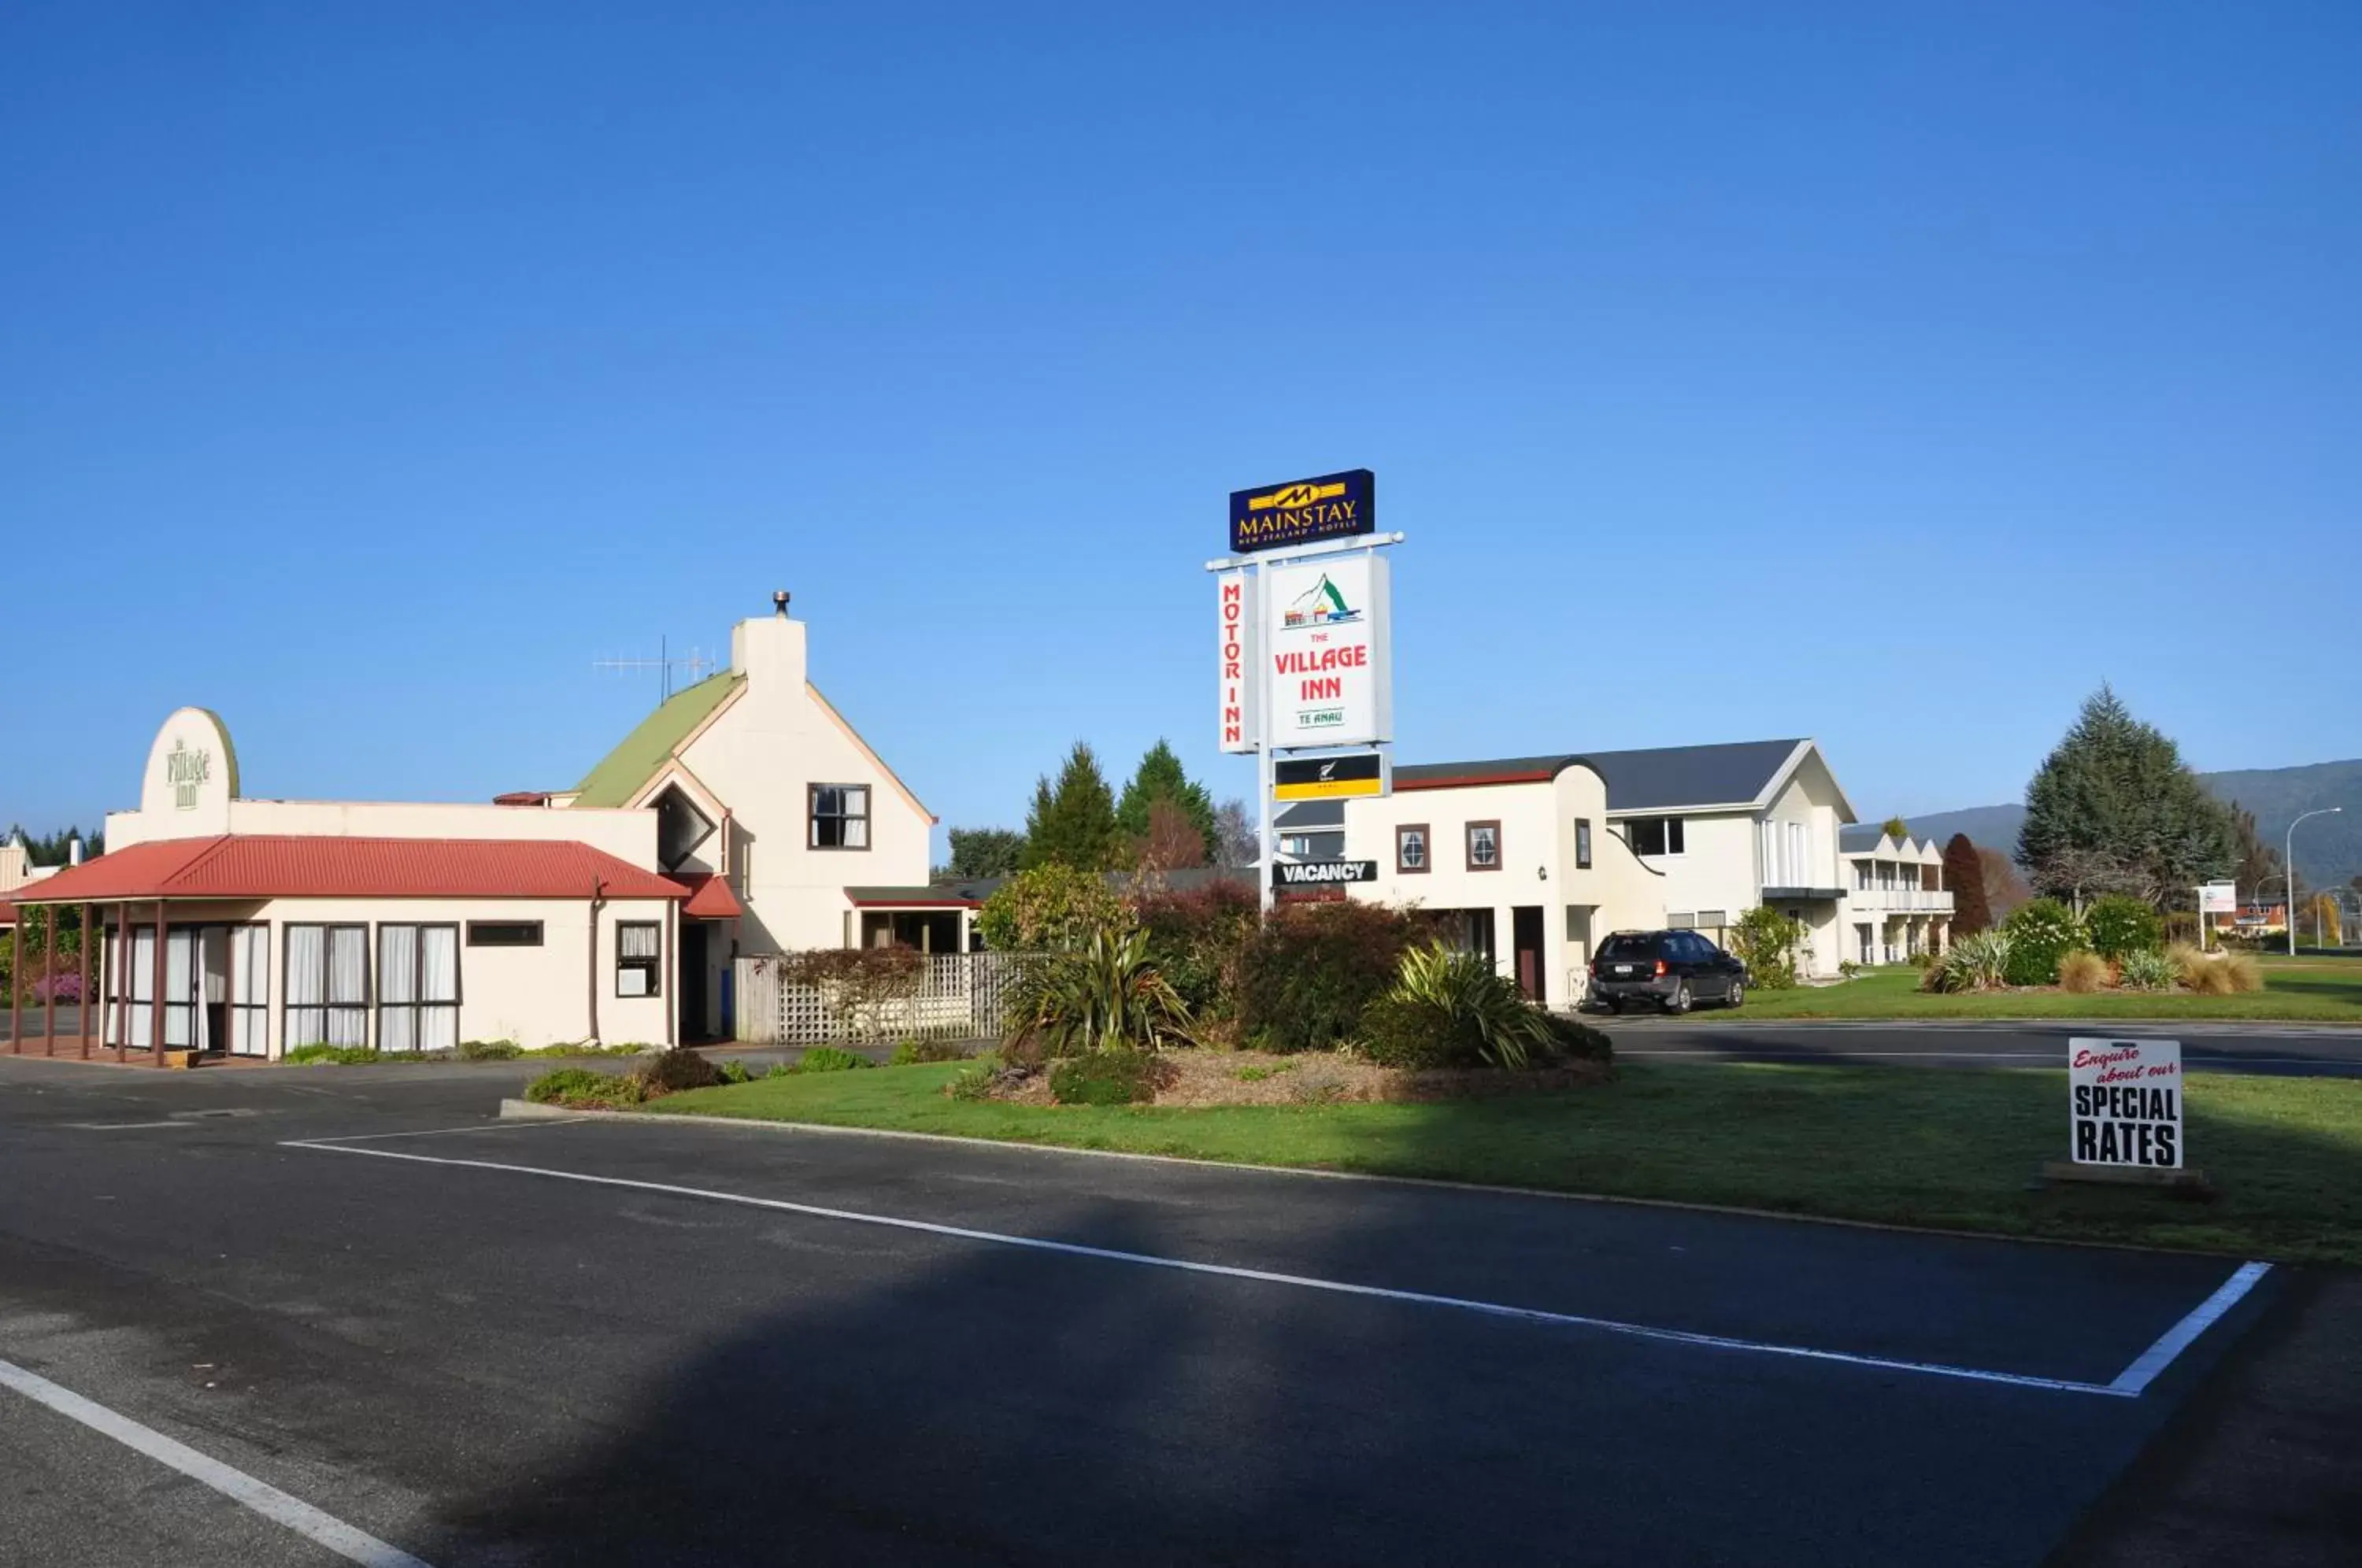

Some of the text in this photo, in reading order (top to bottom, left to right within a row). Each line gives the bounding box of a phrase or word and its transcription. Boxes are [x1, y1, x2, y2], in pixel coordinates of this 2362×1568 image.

[1238, 500, 1357, 536] MAINSTAY
[1238, 519, 1357, 545] NEW ZEALAND HOTELS
[1310, 632, 1329, 643] THE
[1224, 584, 1240, 742] MOTOR INN
[1275, 645, 1368, 675] VILLAGE
[1301, 677, 1342, 701] INN
[1299, 712, 1343, 724] TE ANAU
[1282, 862, 1367, 882] VACANCY
[2073, 1048, 2141, 1069] Enquire
[2096, 1061, 2177, 1084] about our
[2075, 1085, 2178, 1121] SPECIAL
[2076, 1120, 2175, 1167] RATES
